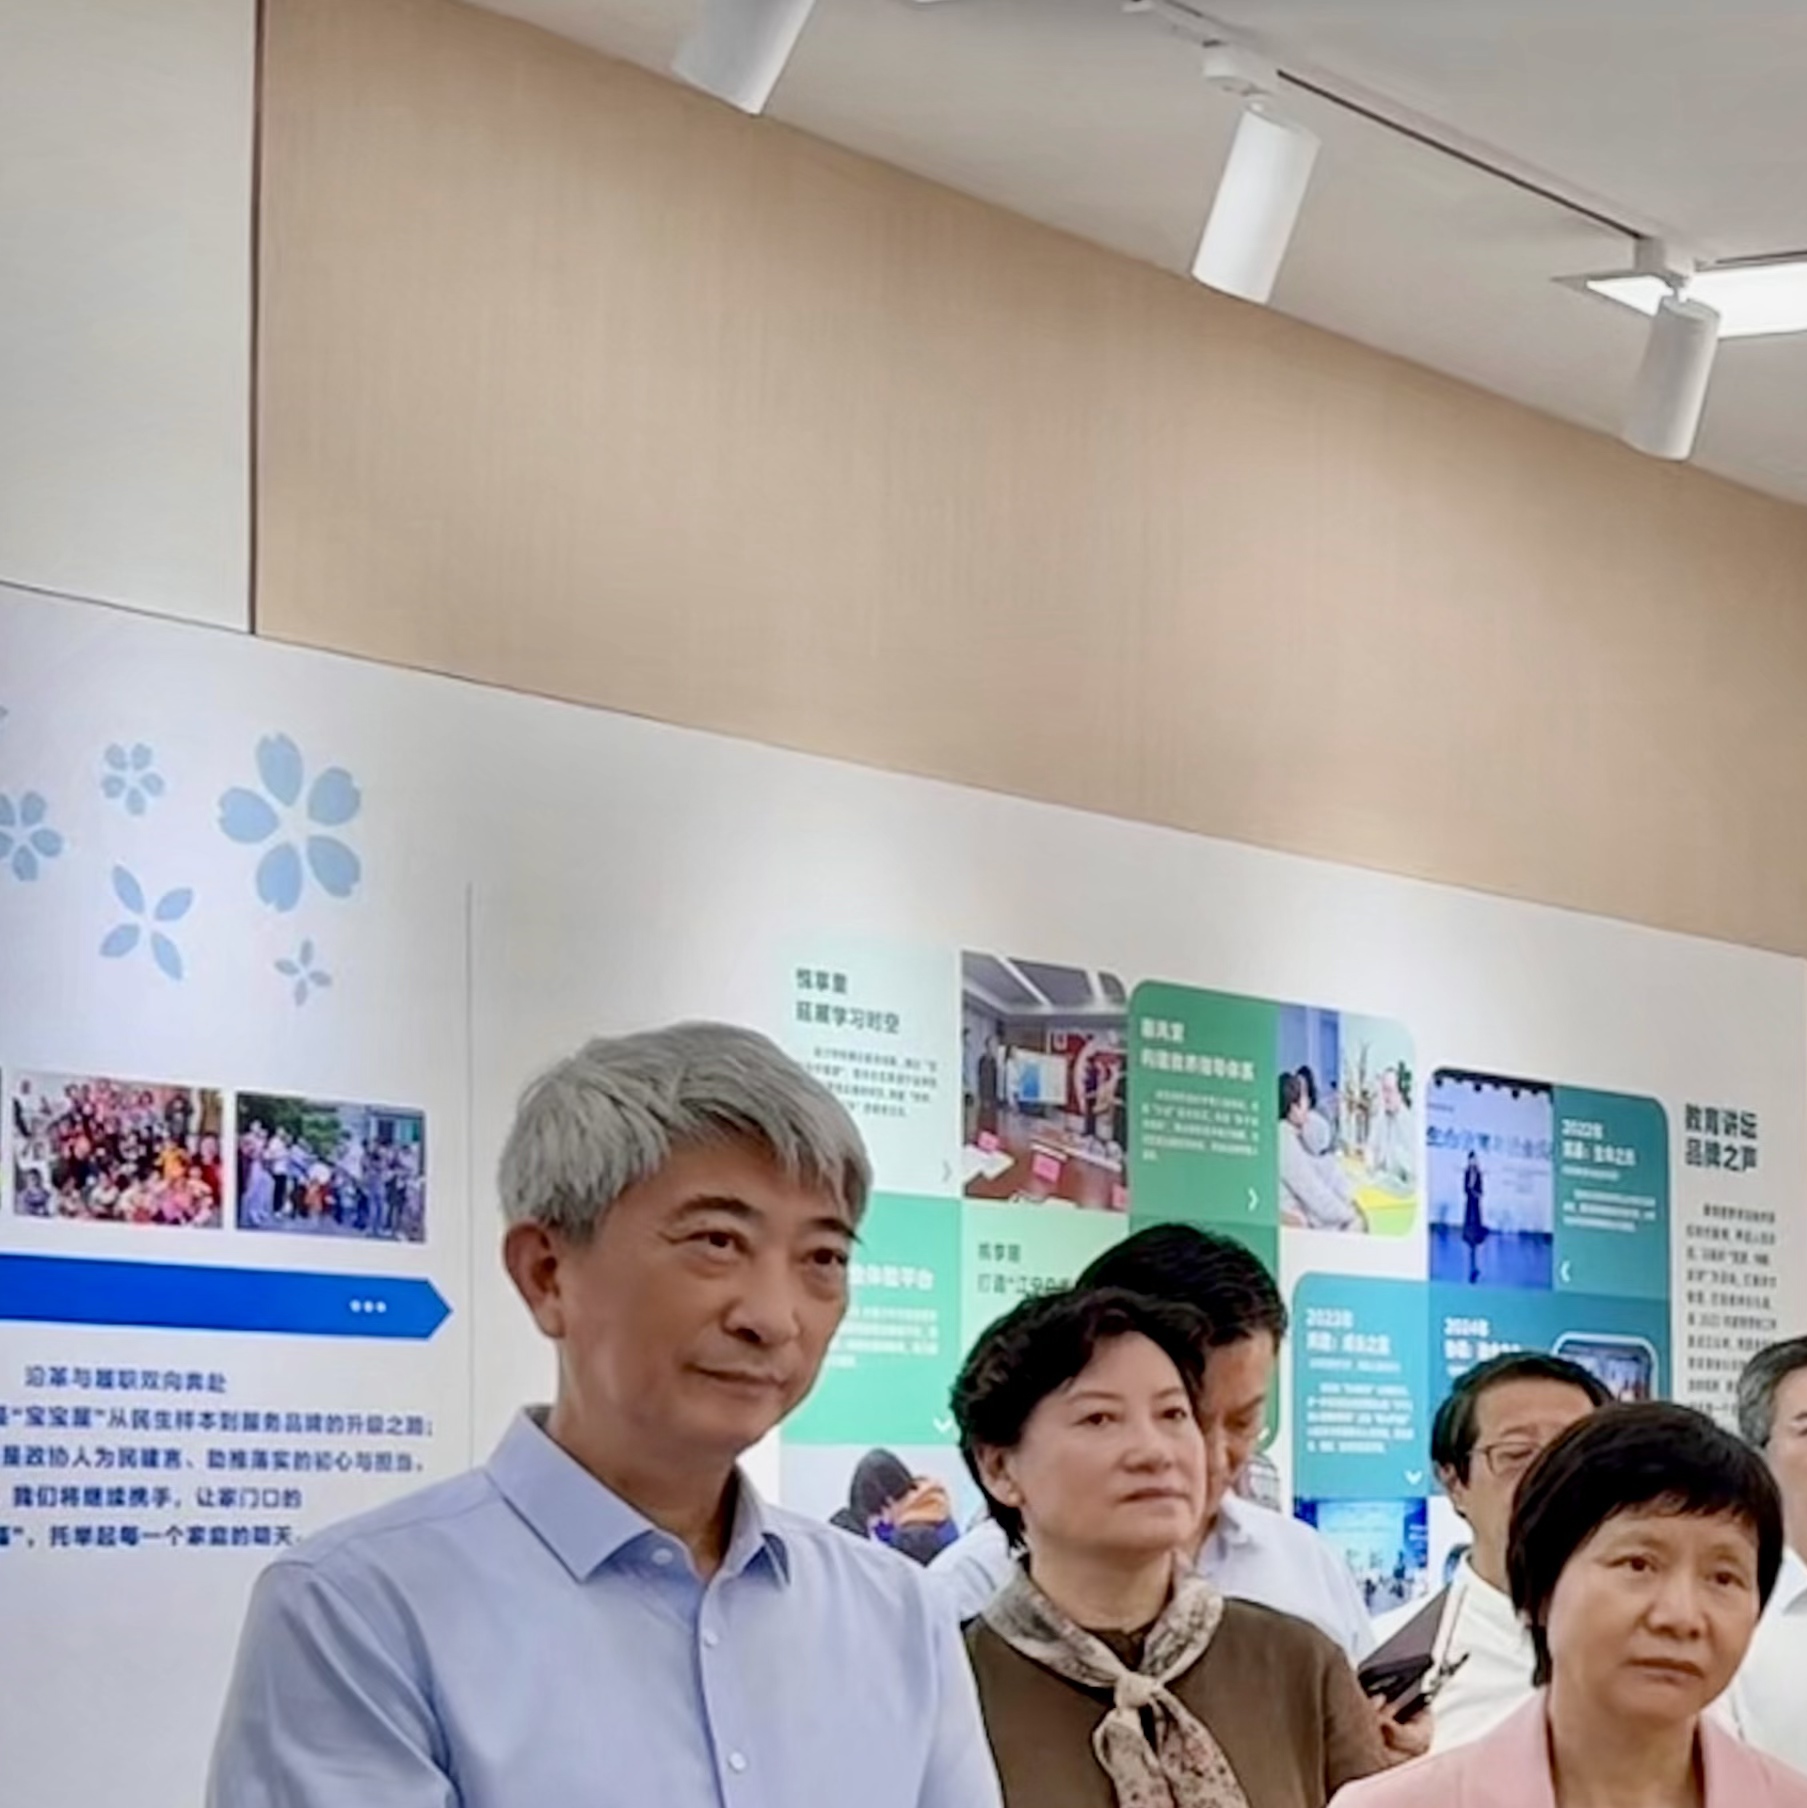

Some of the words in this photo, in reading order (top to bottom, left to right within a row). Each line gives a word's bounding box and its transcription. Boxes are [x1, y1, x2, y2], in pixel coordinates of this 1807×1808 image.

[1684, 1102, 1757, 1139] 教育讲坛
[1684, 1137, 1757, 1171] 品牌之声
[24, 1365, 227, 1394] 沿革与履职双向奔赴
